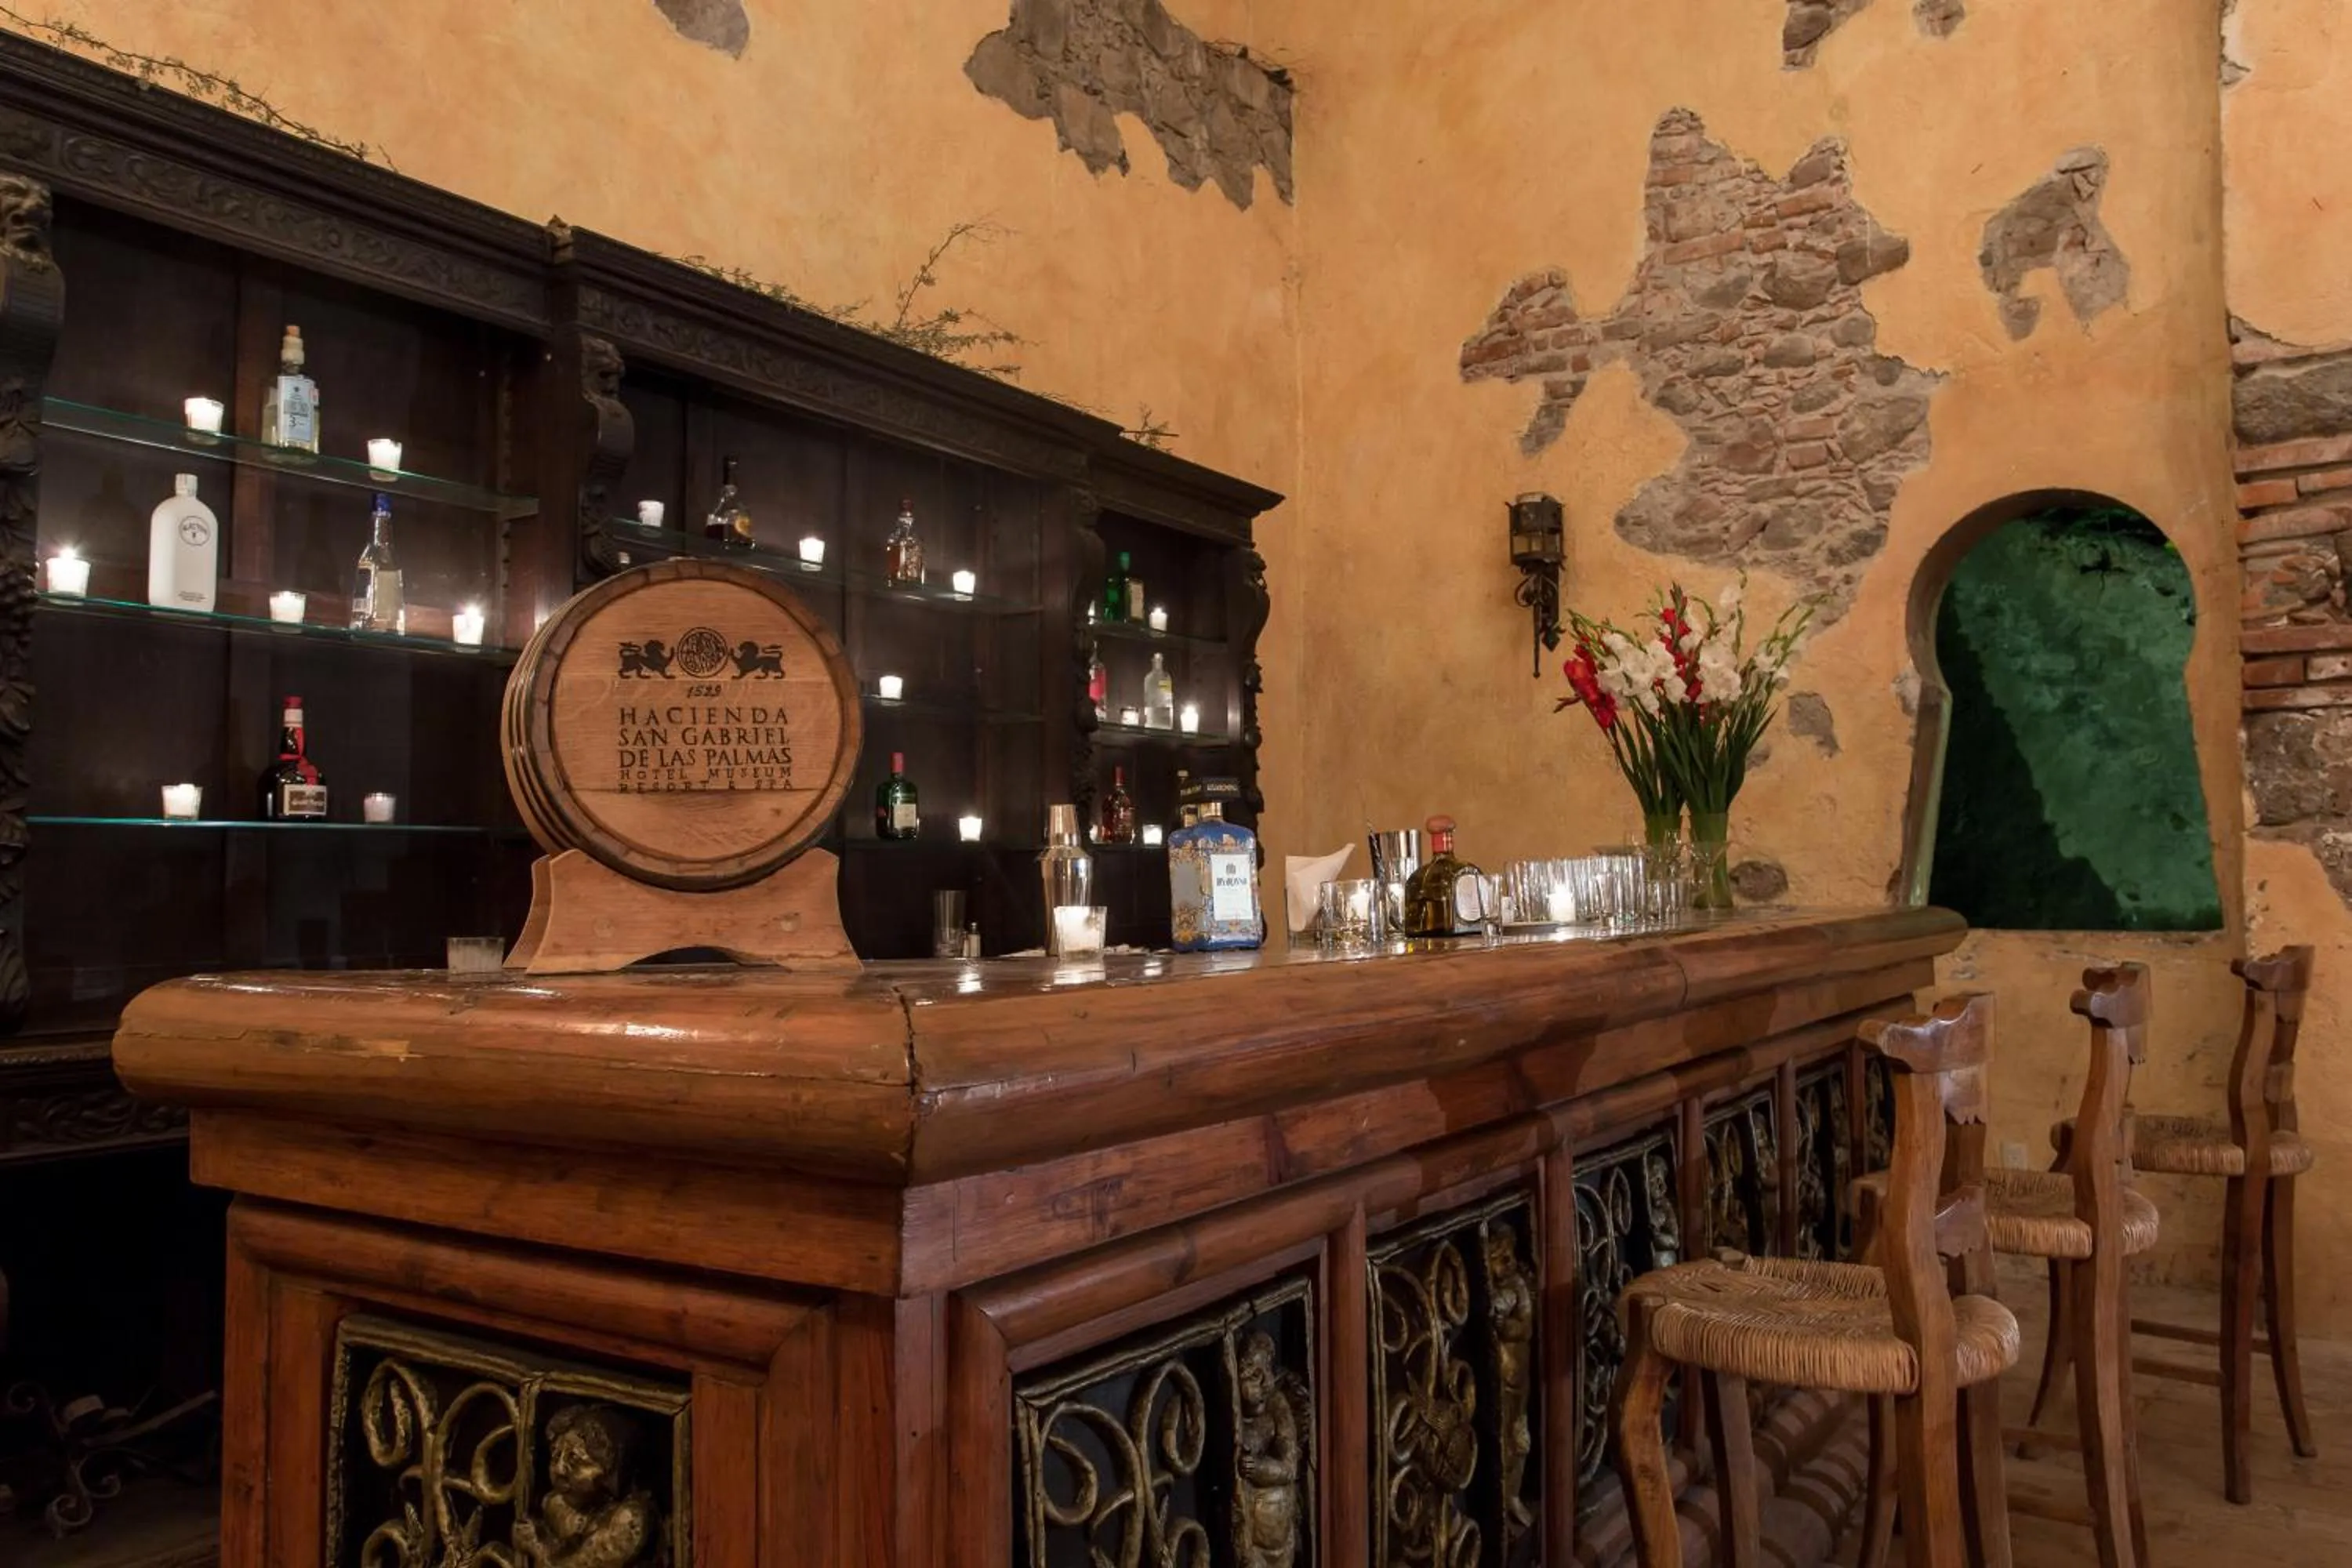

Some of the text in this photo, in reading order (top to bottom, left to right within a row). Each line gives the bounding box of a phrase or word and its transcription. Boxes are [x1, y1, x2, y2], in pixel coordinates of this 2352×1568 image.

[687, 684, 722, 699] 1529
[619, 707, 788, 725] HACIENDA
[619, 728, 790, 746] SAN GABRIEL
[619, 747, 793, 768] DE LAS PALMAS
[620, 767, 791, 780] HOTEL MUSEUM
